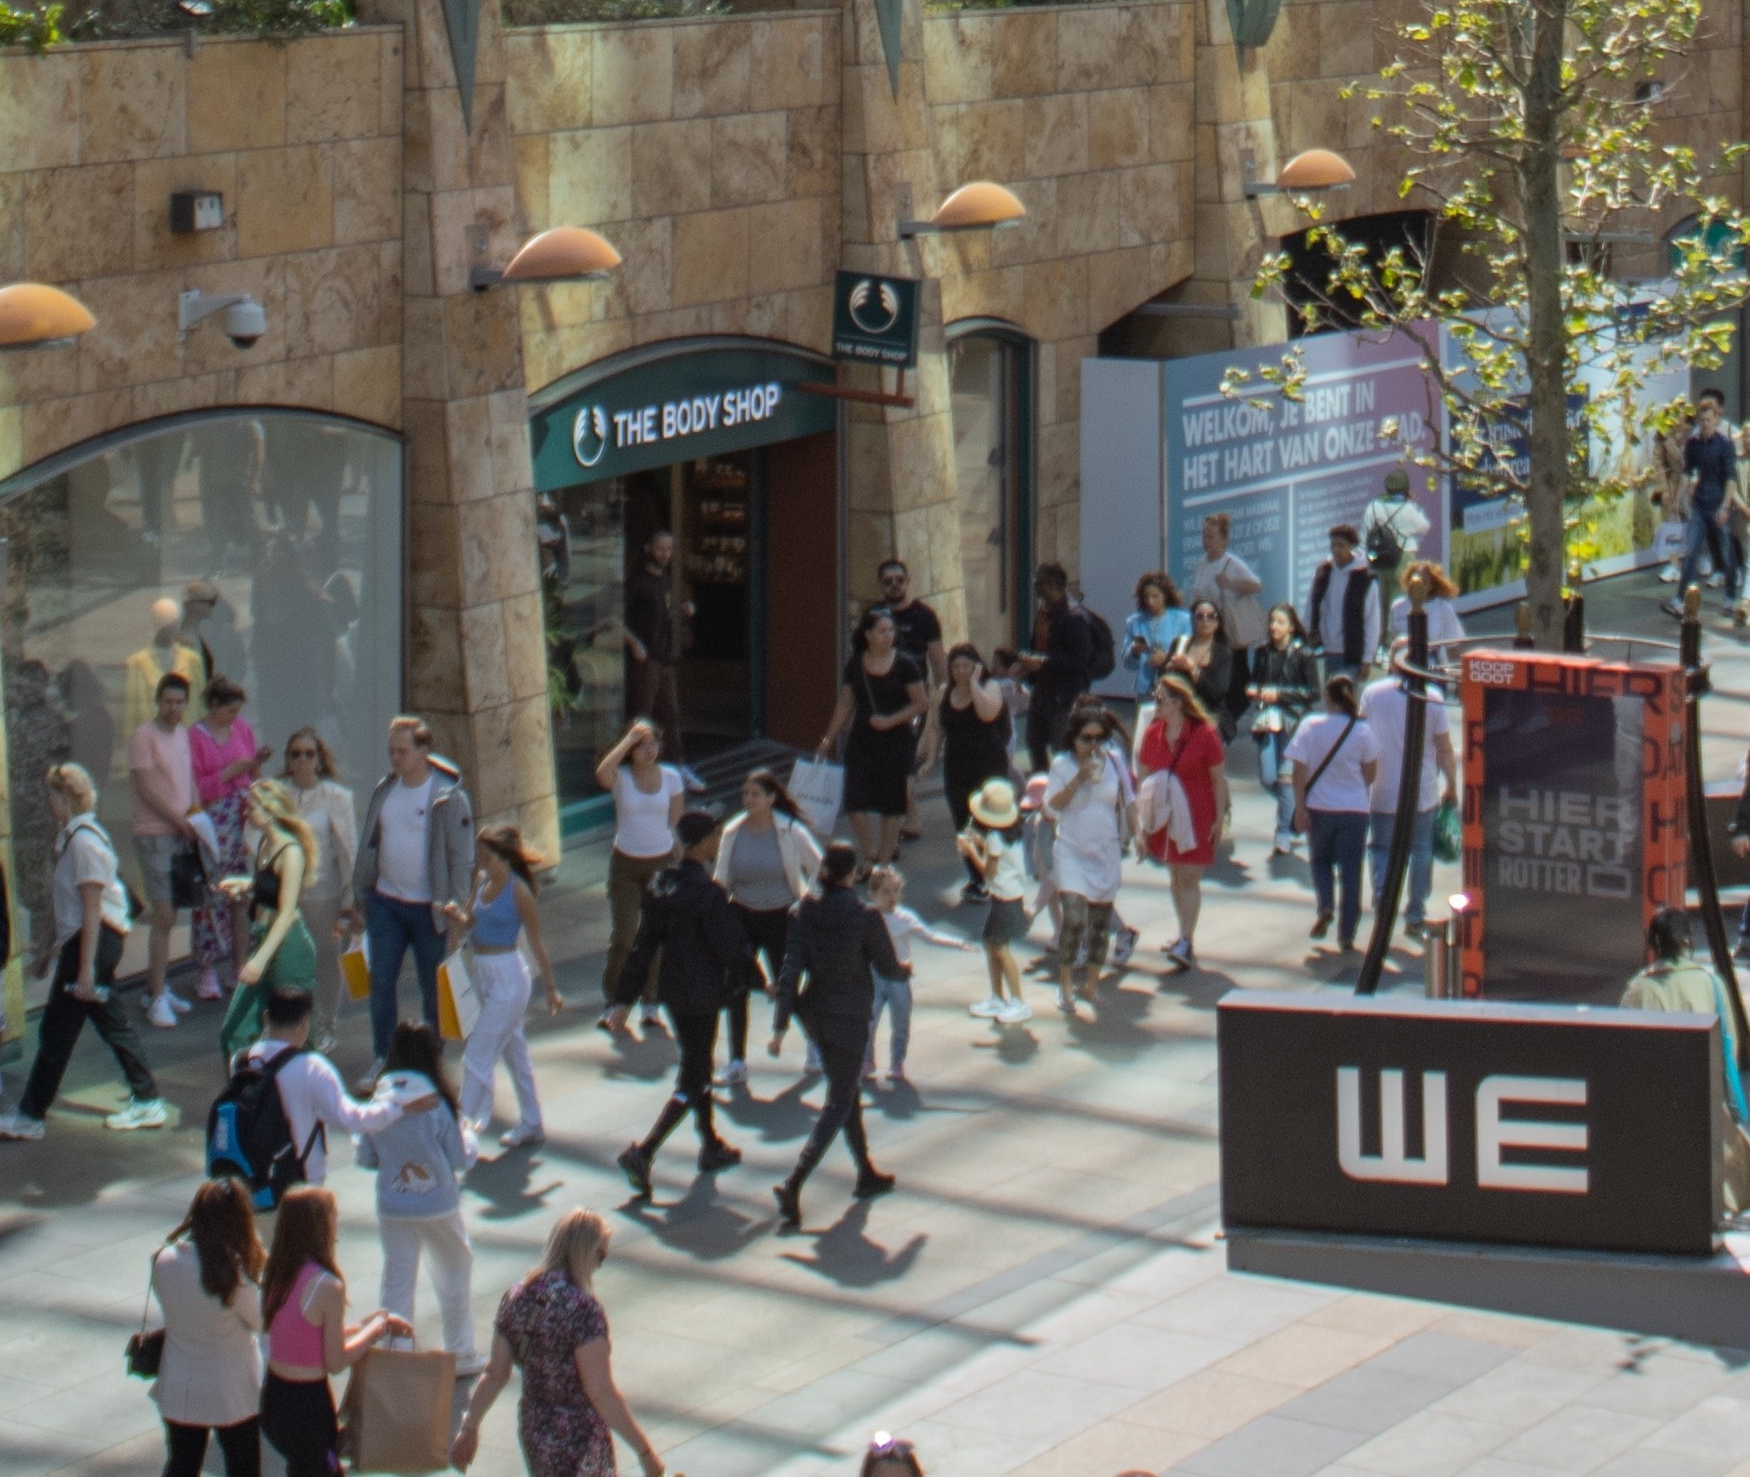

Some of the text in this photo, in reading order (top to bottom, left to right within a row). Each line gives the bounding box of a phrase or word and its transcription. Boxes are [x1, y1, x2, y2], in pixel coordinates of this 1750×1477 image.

[613, 381, 782, 449] THE BODY SHOP
[1182, 403, 1274, 448] WELKOM,
[1304, 383, 1351, 424] BENT
[1355, 380, 1375, 414] IN
[1183, 450, 1218, 491] HET
[1224, 439, 1274, 482] HART
[1278, 431, 1319, 470] VAN
[1324, 419, 1375, 461] ONZE
[1500, 786, 1637, 829] HIER
[1499, 823, 1635, 864] START
[1337, 1065, 1589, 1196] WE
